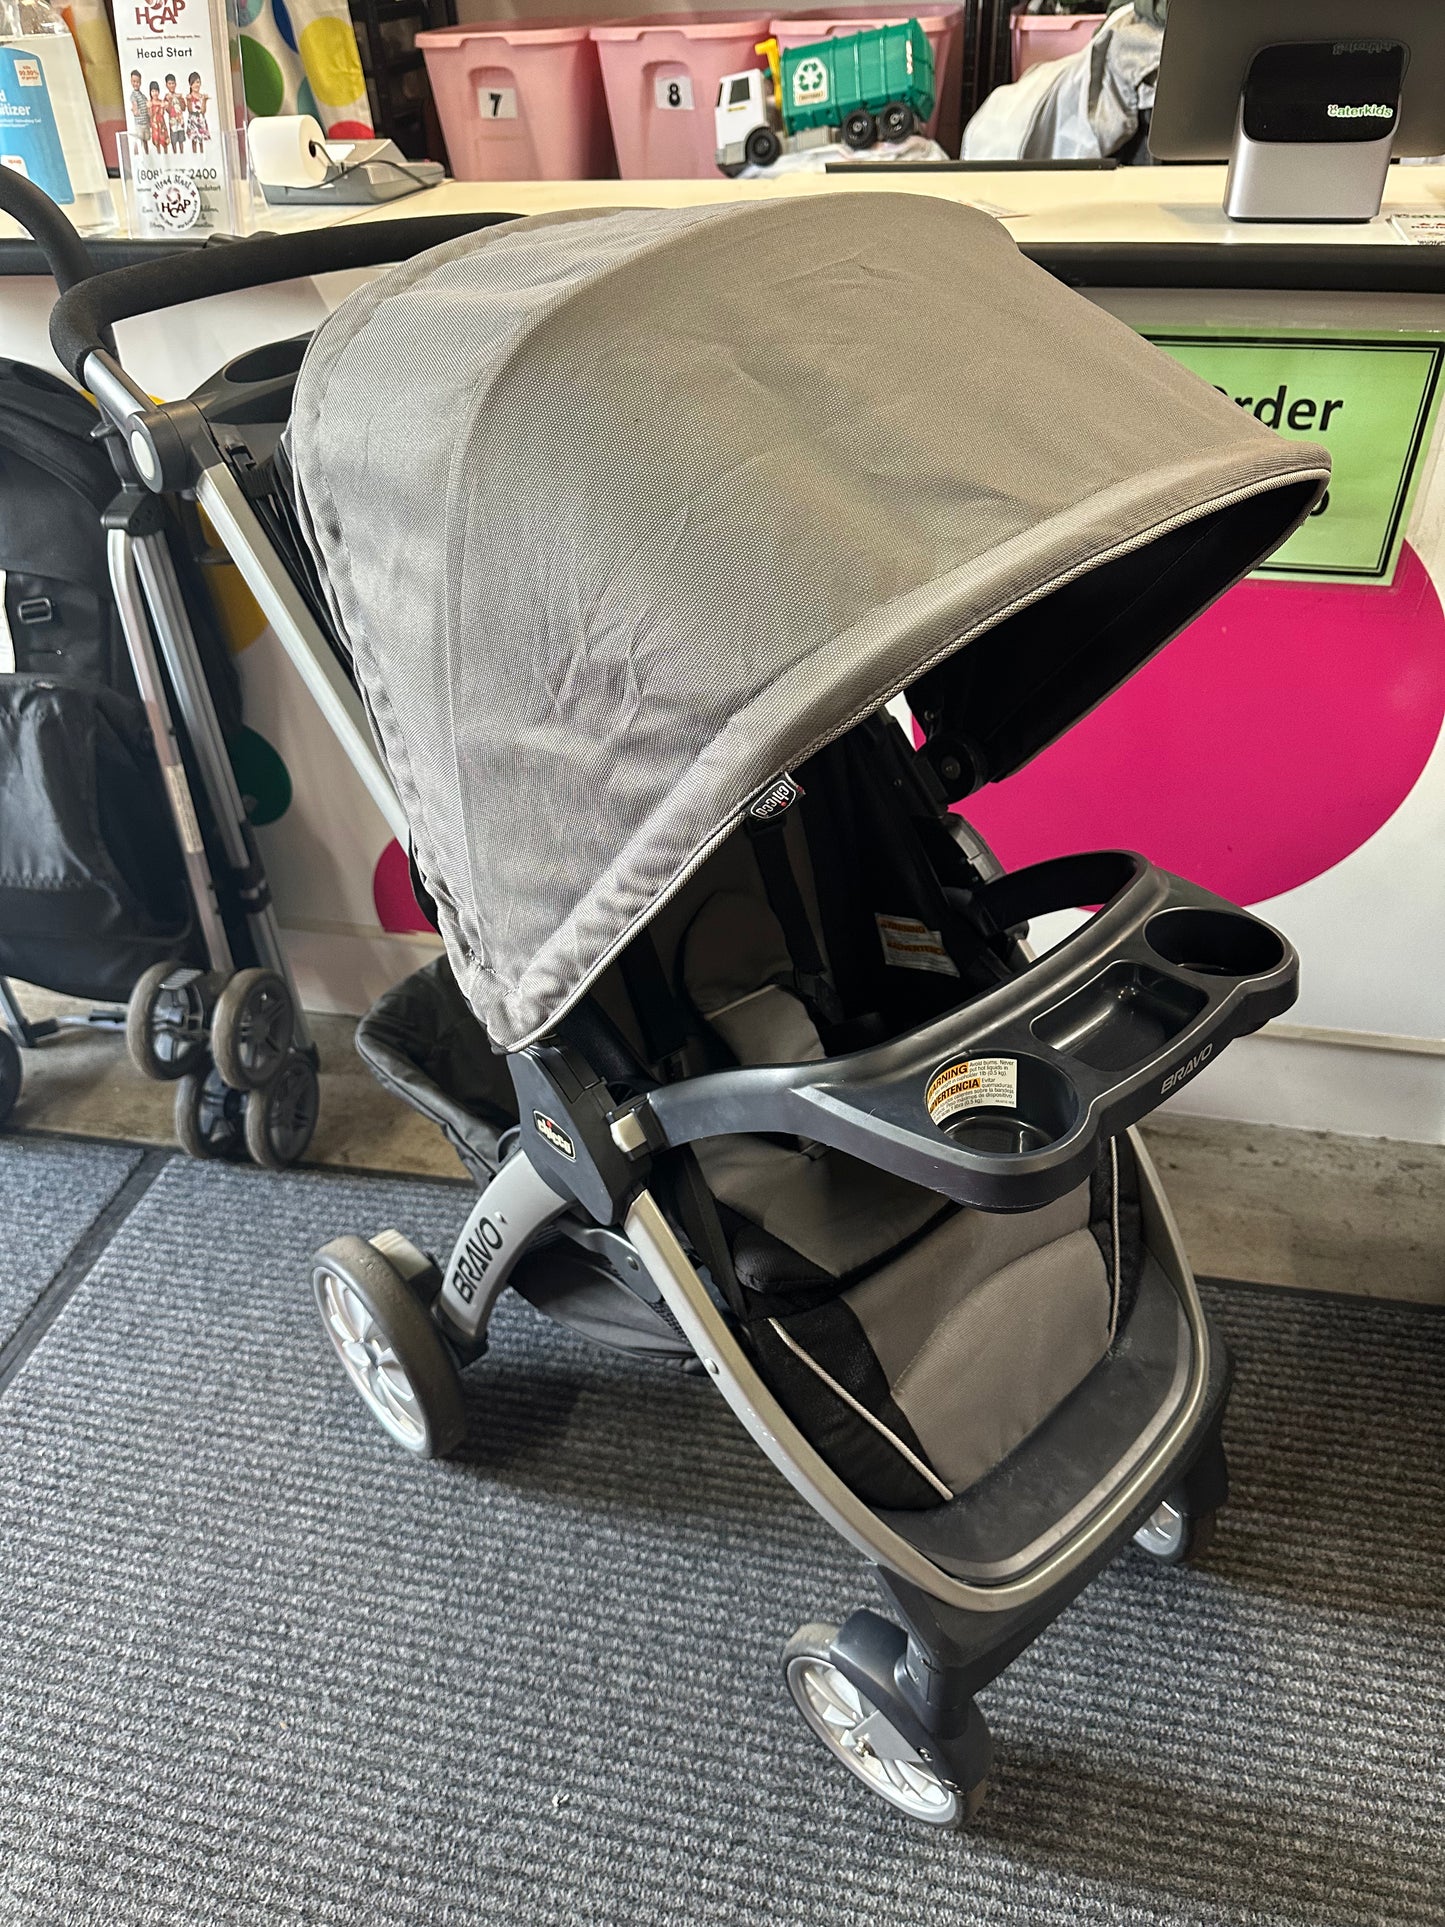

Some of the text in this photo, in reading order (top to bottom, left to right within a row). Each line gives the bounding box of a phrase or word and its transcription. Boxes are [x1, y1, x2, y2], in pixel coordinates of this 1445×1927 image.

[135, 0, 186, 33] HCAP
[136, 46, 193, 59] Head Start
[488, 93, 503, 117] 7
[668, 83, 681, 107] 8
[1211, 385, 1343, 431] rder
[756, 786, 789, 816] chicco
[1161, 1043, 1213, 1094] BRAVO
[452, 1217, 503, 1304] BRAVO
